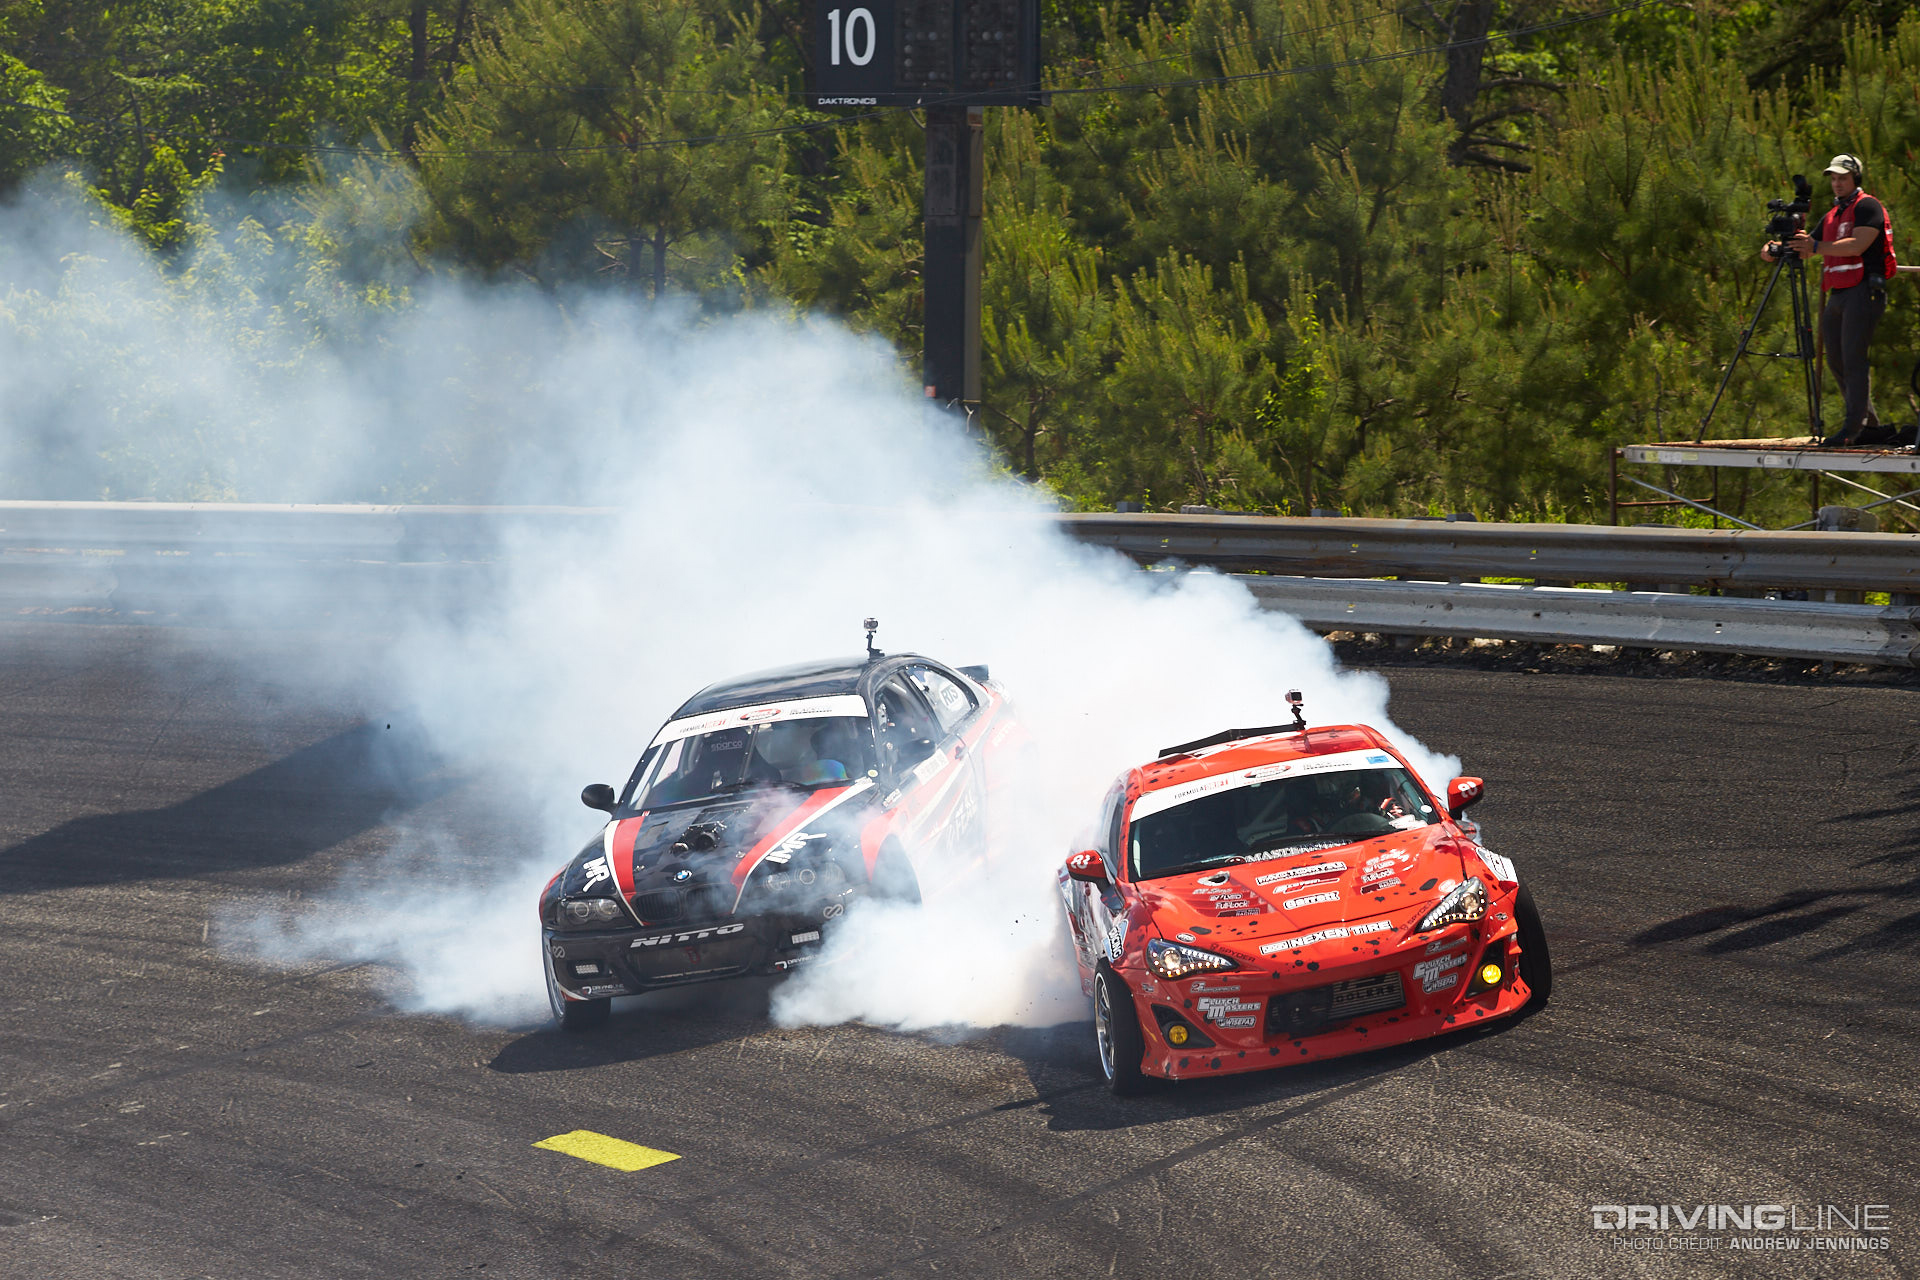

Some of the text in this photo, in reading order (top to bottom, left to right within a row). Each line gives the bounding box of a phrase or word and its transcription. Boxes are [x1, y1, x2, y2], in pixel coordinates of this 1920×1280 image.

[828, 8, 876, 66] 10
[818, 97, 877, 105] DAKTRONICS
[711, 740, 743, 752] sparco
[630, 923, 744, 949] NITTO
[1292, 928, 1349, 947] NEXEN
[1350, 920, 1391, 935] TIRE
[1220, 947, 1256, 962] SPYDER
[1198, 997, 1240, 1011] CLUTCH
[1207, 1003, 1261, 1018] MASTERS
